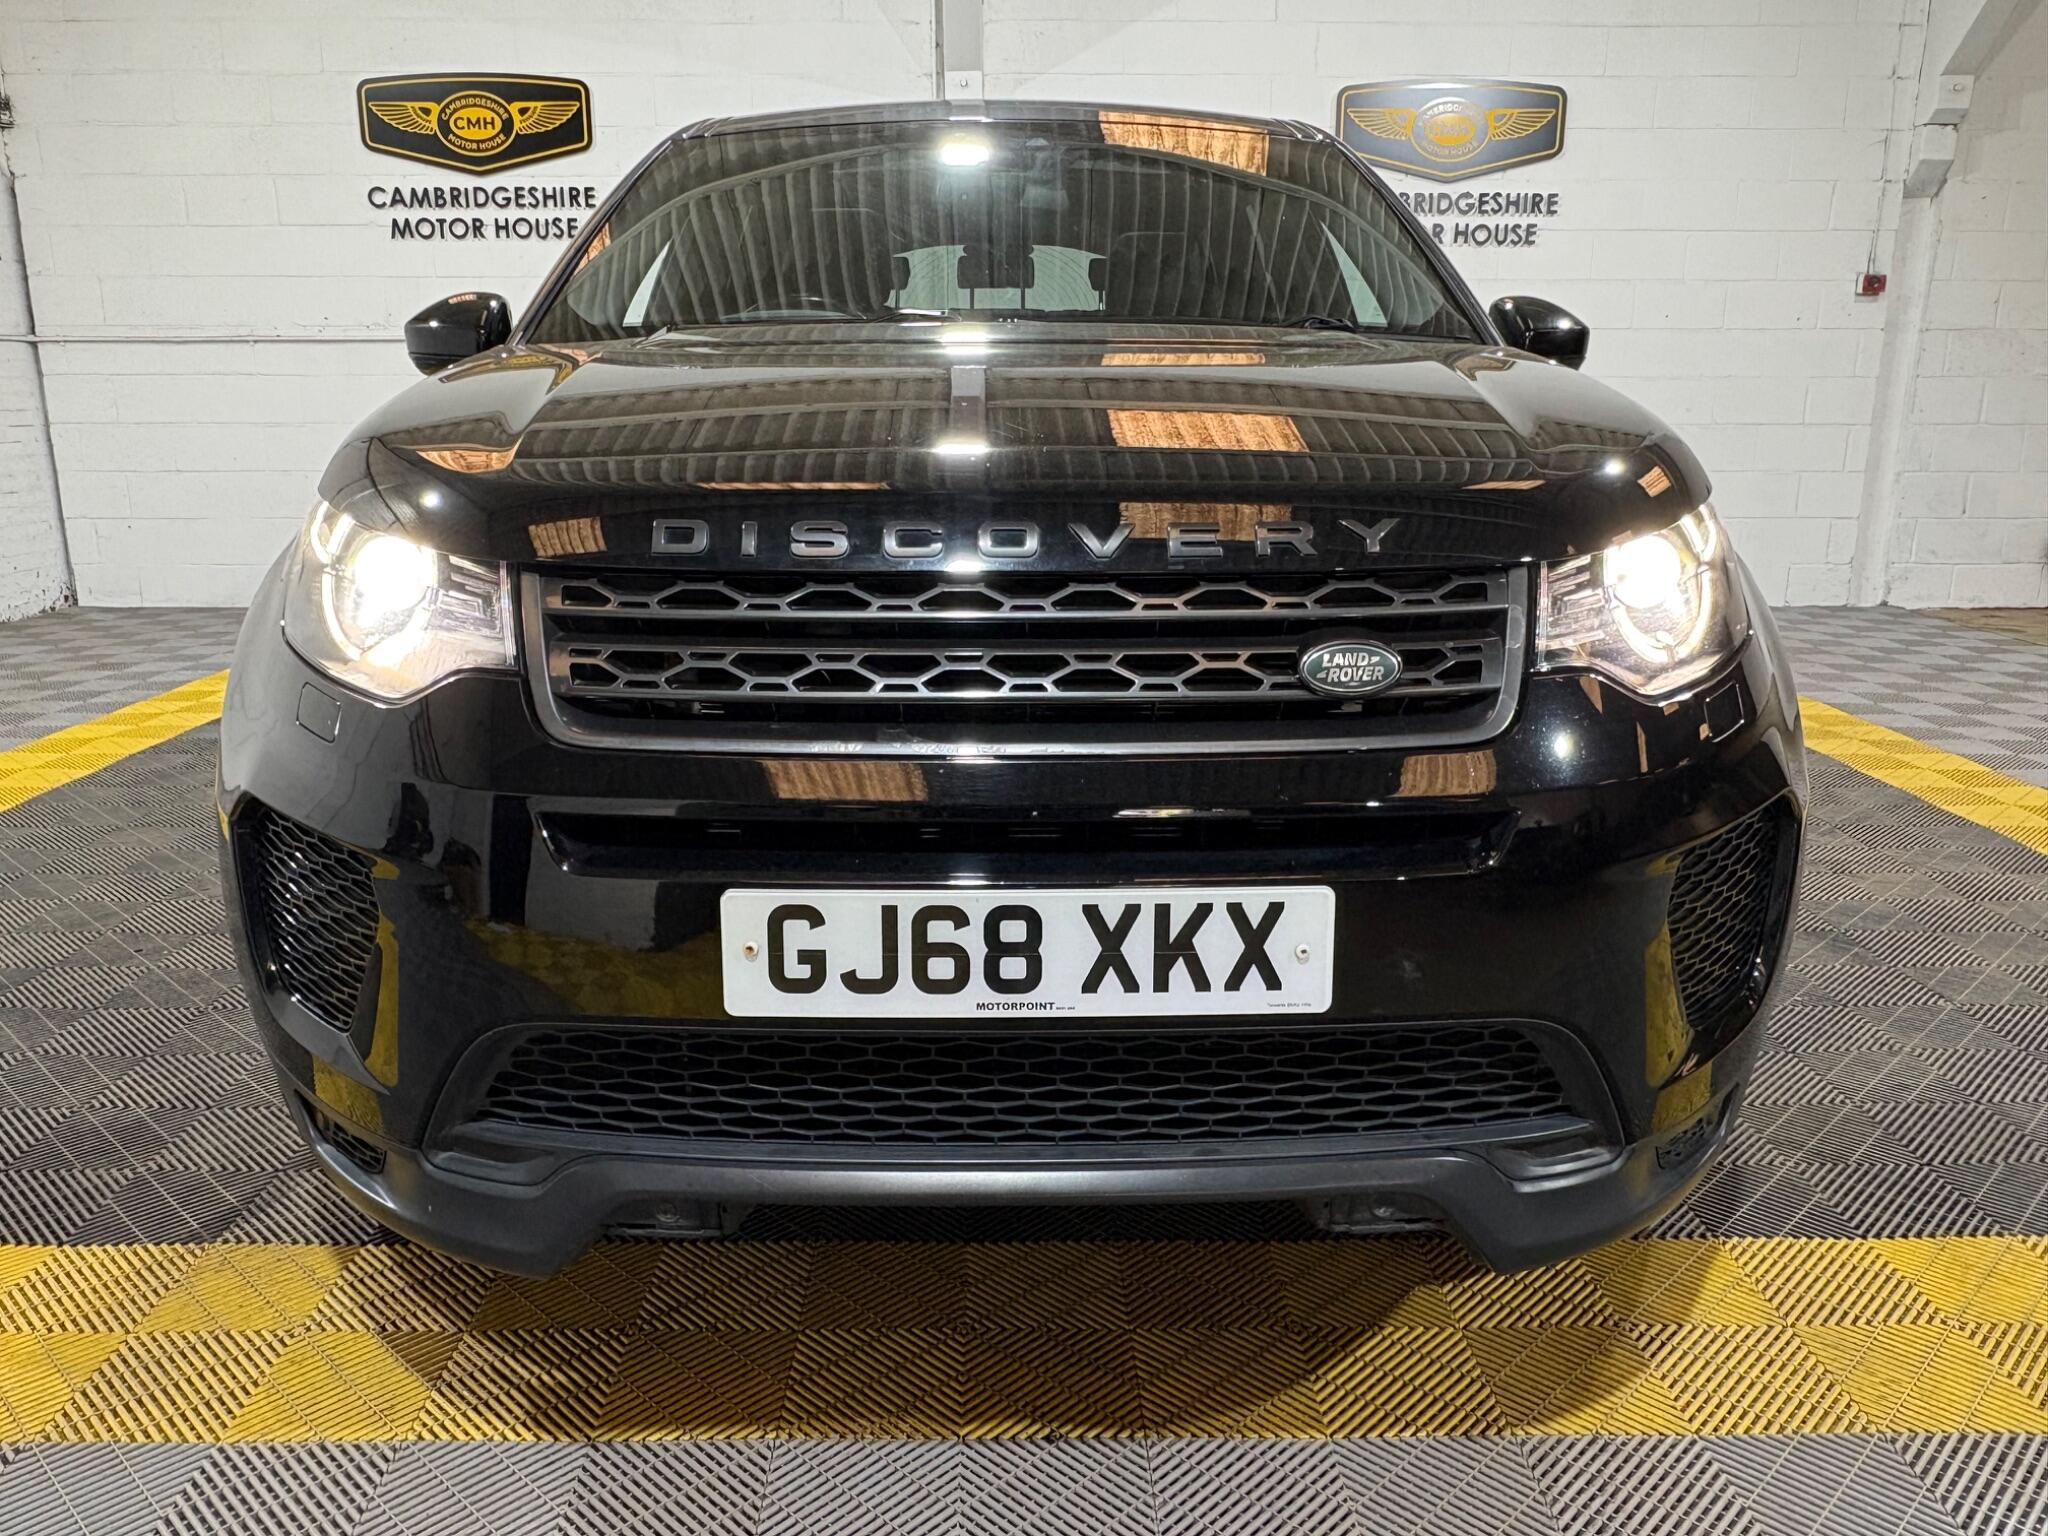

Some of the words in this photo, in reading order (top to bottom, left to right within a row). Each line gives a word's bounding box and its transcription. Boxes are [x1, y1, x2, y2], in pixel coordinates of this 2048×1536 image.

[441, 97, 509, 120] CAMBRIDGESHIRE
[453, 116, 496, 131] CMH
[448, 133, 478, 150] MOTOR
[479, 133, 507, 150] HOUSE
[367, 186, 597, 209] CAMBRIDGESHIRE
[1400, 191, 1559, 216] RIDGESHIRE
[391, 217, 486, 240] MOTOR
[494, 217, 579, 240] HOUSE
[1453, 223, 1538, 246] HOUSE
[651, 518, 1401, 560] DISCOVERY
[1321, 652, 1369, 668] LAND
[1327, 666, 1385, 682] ROVER
[766, 903, 1044, 995] GJ68
[1081, 901, 1286, 994] XKX
[976, 1002, 1055, 1011] MOTORPOINT
